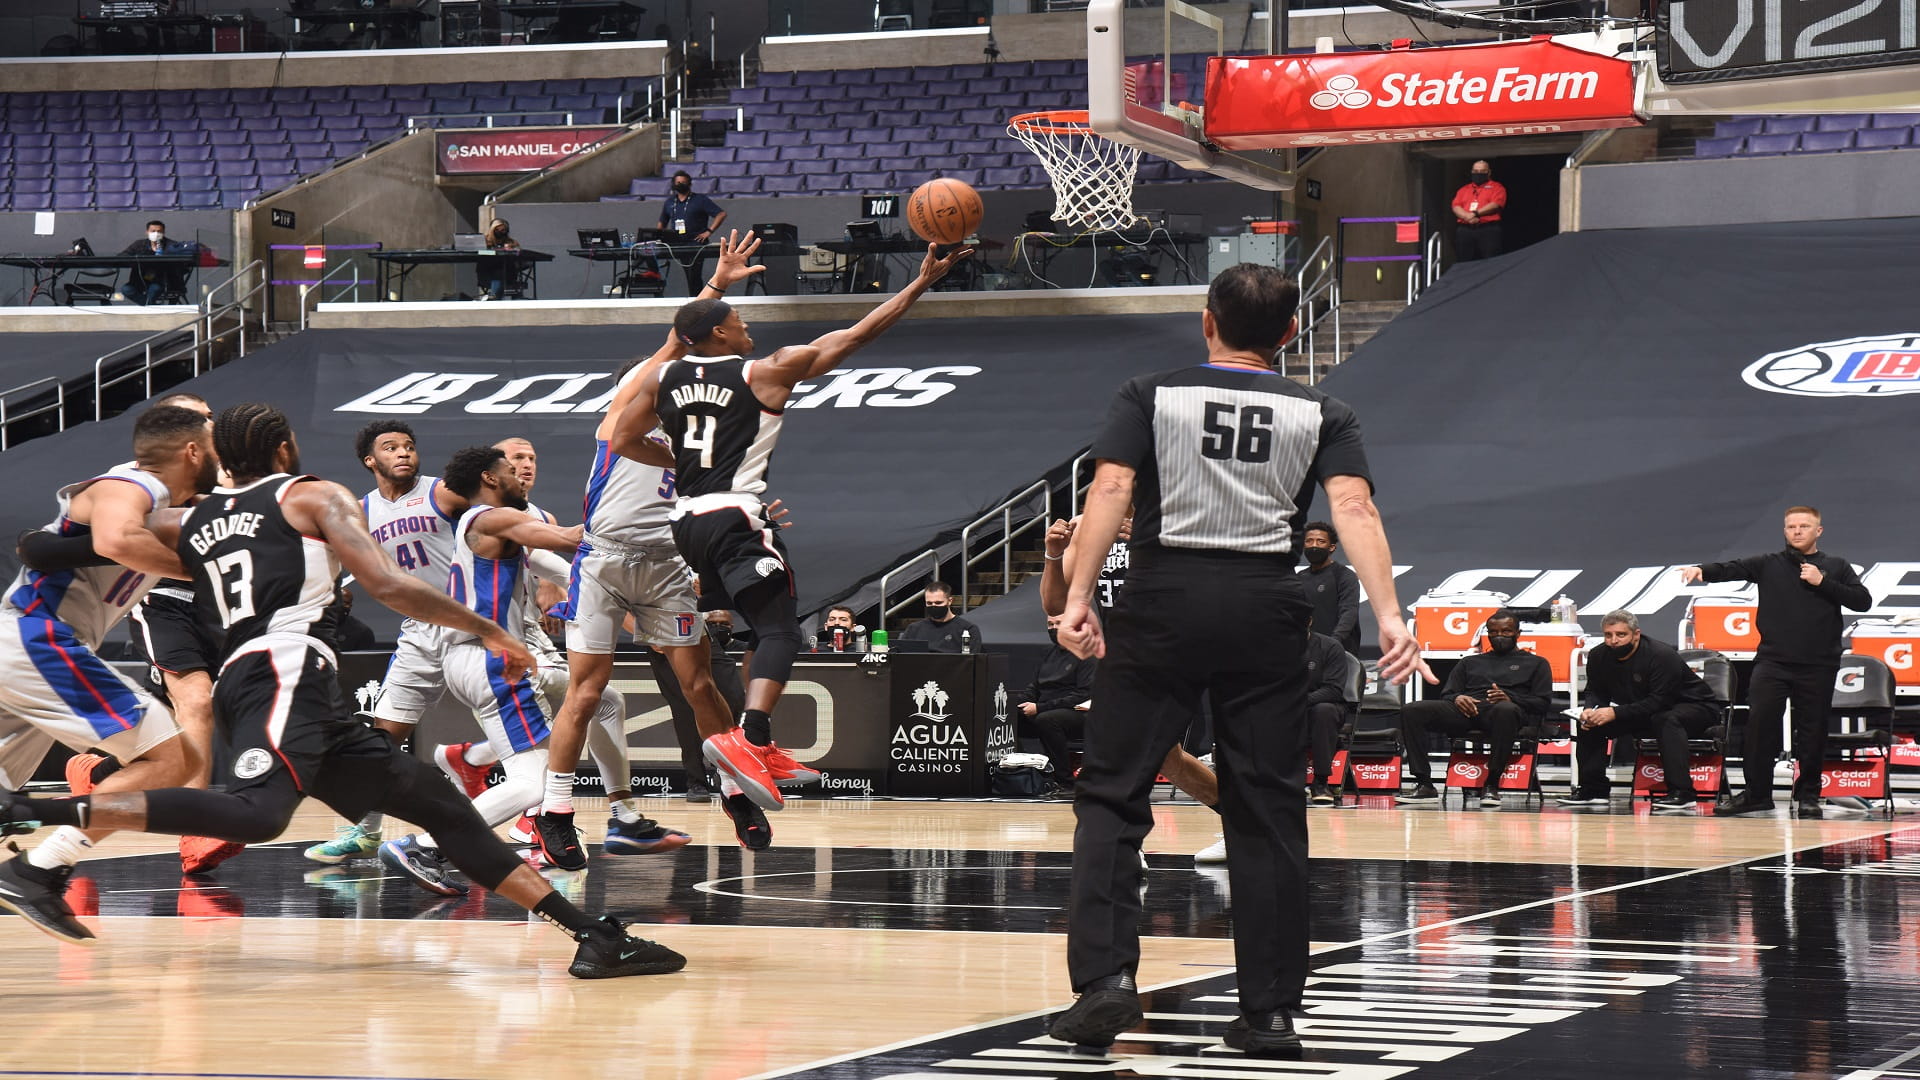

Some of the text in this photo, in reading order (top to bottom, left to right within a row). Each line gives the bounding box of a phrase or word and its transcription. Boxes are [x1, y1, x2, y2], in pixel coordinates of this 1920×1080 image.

[460, 145, 491, 157] SAN
[494, 144, 558, 156] MANUEL
[871, 200, 892, 215] 101
[333, 372, 498, 413] LA
[671, 384, 734, 408] RONDO
[684, 415, 717, 468] 4
[1201, 401, 1273, 463] 56
[189, 512, 264, 556] GEORGE
[397, 540, 430, 570] 41
[103, 569, 146, 607] 18
[203, 549, 256, 629] 13
[1444, 612, 1469, 635] G
[1724, 612, 1750, 636] G
[861, 654, 887, 663] ANC
[1884, 643, 1912, 669] G
[892, 725, 968, 744] AGUA
[987, 724, 1015, 748] AGUA
[891, 748, 968, 761] CALIENTE
[898, 764, 962, 773] CASINOS
[1356, 764, 1396, 772] Cedars
[1361, 772, 1389, 780] Sinai
[1690, 773, 1708, 781] nai
[1832, 770, 1879, 779] Cedars
[632, 775, 672, 794] oney
[821, 772, 874, 794] honey
[1838, 779, 1871, 788] Sinai
